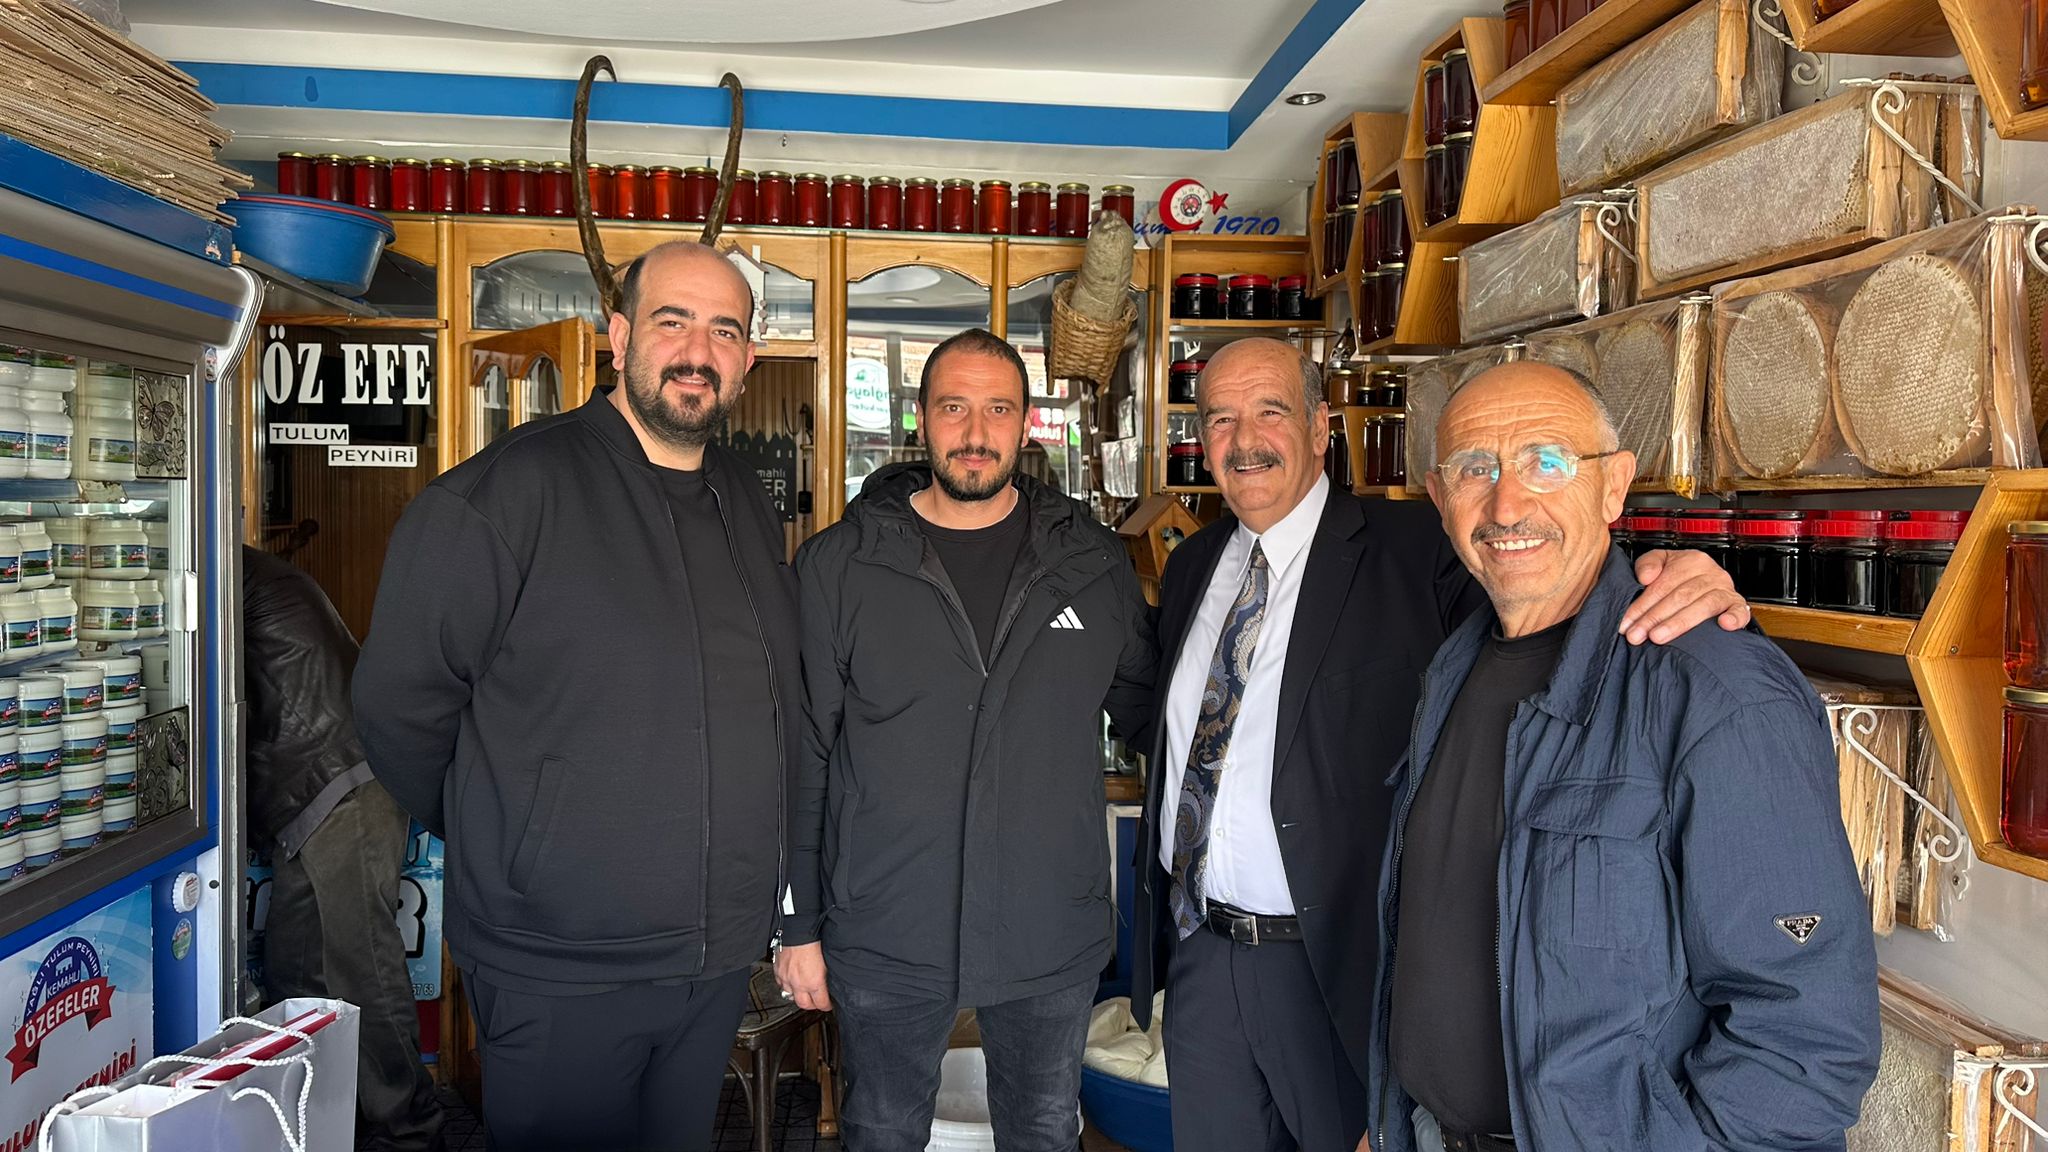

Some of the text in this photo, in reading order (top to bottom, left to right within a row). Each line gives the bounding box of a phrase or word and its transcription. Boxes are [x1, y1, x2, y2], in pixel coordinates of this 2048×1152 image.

[1213, 215, 1280, 235] 1970
[263, 325, 431, 405] ÖZ EFE
[272, 427, 347, 441] TULUM
[331, 448, 414, 463] PEYNİRİ
[44, 942, 75, 968] TULUM
[24, 984, 101, 1048] ÖZEFELER
[63, 1038, 137, 1102] YNİRİ
